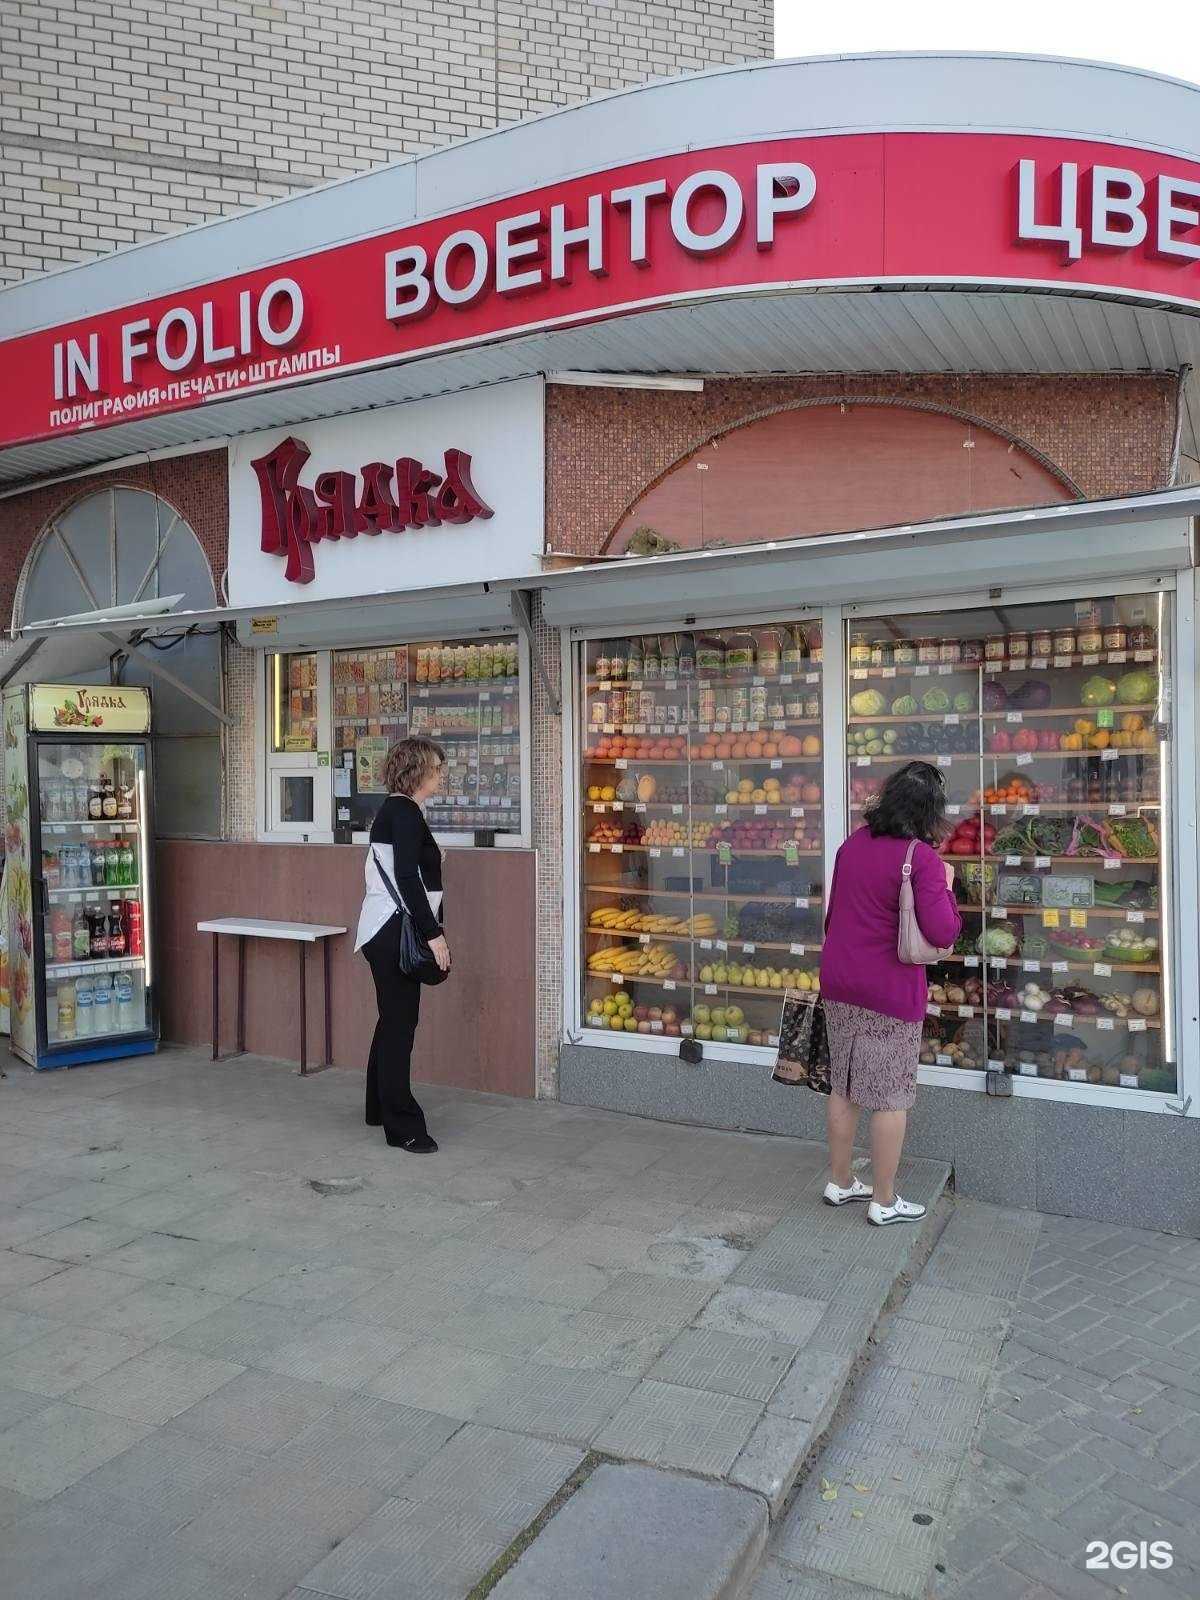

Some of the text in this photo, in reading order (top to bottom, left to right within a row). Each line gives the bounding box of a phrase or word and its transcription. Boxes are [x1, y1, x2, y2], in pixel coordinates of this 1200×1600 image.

[386, 162, 817, 320] ВОЕНТОР
[1018, 159, 1200, 259] ЦВЕ
[53, 277, 304, 400] IN FOLIO
[250, 436, 495, 584] Грядка
